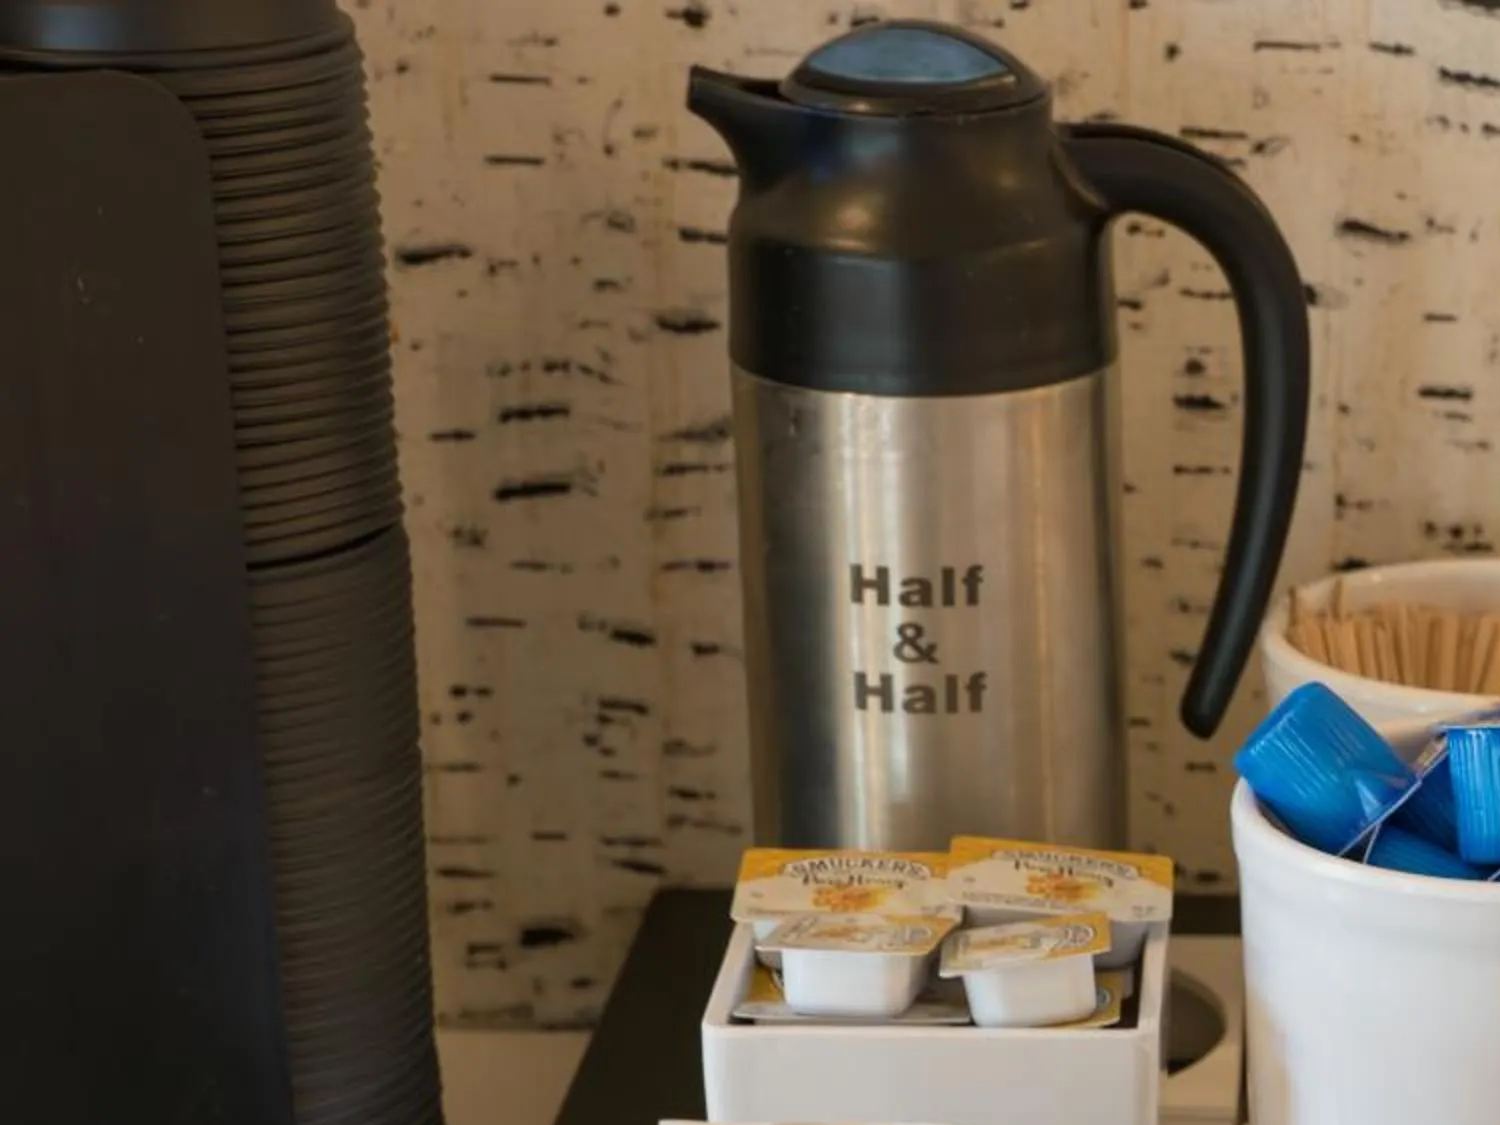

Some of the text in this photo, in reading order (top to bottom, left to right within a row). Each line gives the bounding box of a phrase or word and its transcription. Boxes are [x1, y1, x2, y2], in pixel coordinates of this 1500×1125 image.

[850, 564, 983, 607] Half
[893, 621, 938, 663] &
[854, 671, 987, 714] Half
